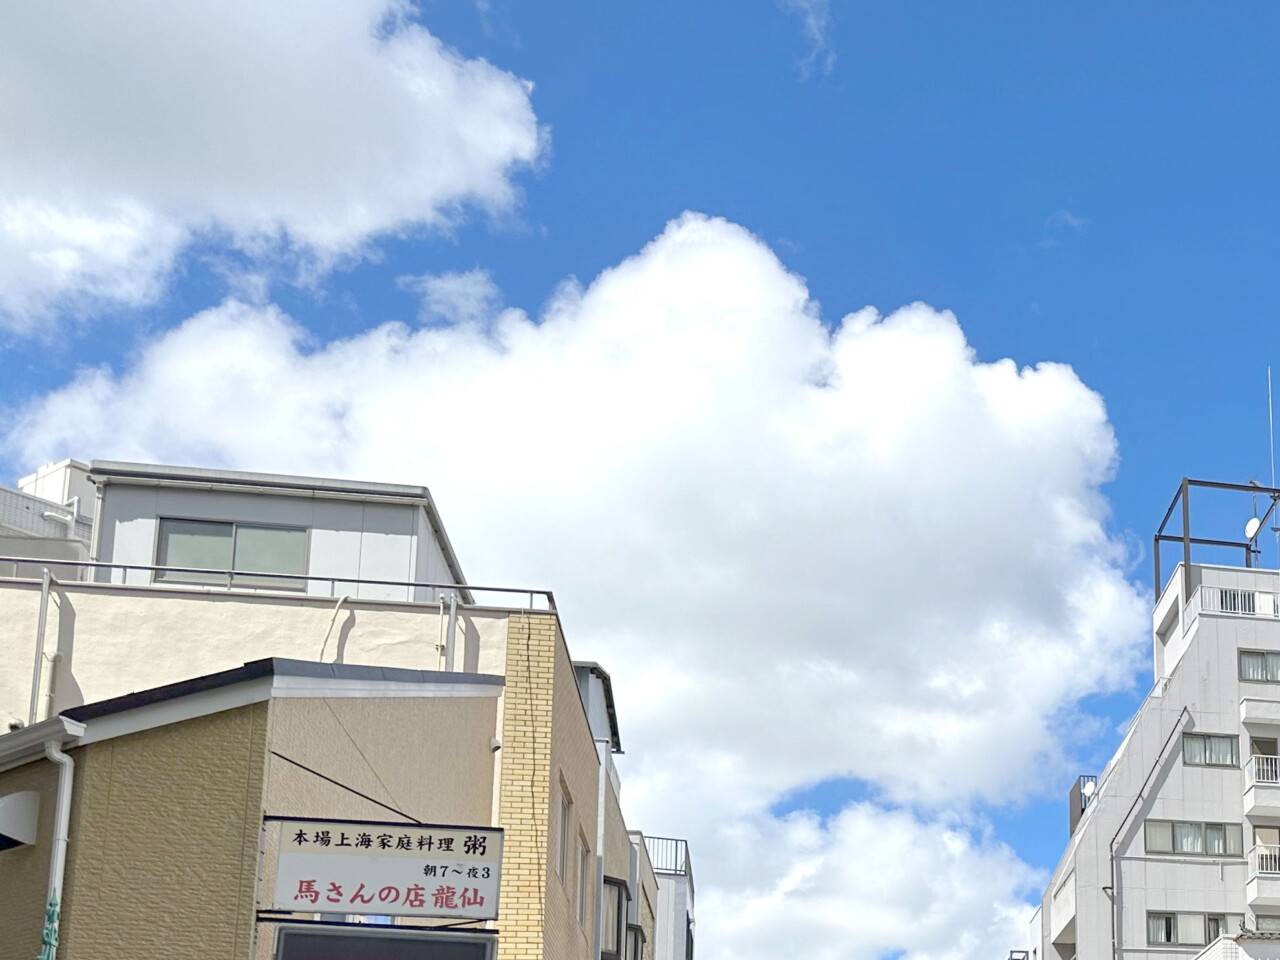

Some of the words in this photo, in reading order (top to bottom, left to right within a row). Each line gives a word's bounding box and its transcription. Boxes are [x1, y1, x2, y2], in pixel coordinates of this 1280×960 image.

[292, 829, 455, 852] 本場上海家庭料理
[463, 834, 487, 856] 粥
[293, 879, 485, 909] 馬さんの店龍仙
